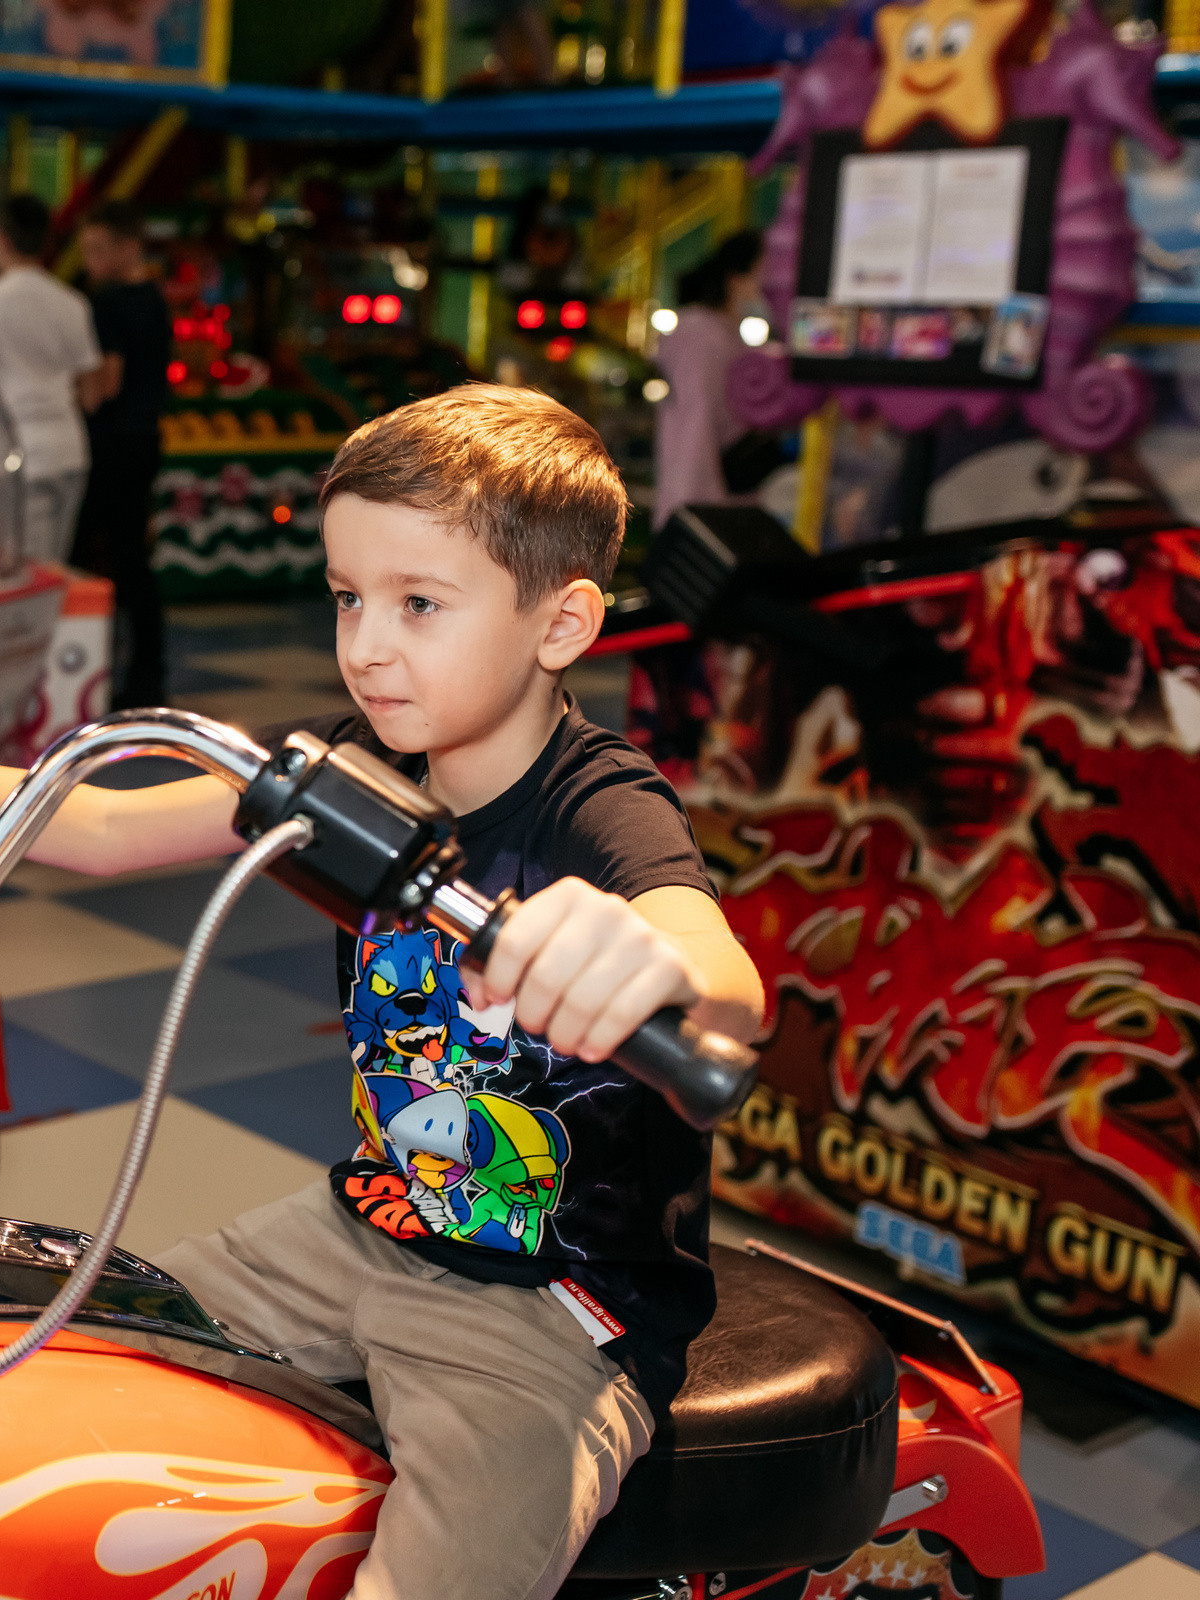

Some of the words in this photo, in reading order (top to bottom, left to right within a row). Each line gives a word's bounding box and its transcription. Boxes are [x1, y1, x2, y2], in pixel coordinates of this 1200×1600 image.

[815, 1116, 1032, 1255] GOLDEN
[1046, 1206, 1180, 1315] GUN
[858, 1204, 964, 1284] SEGA
